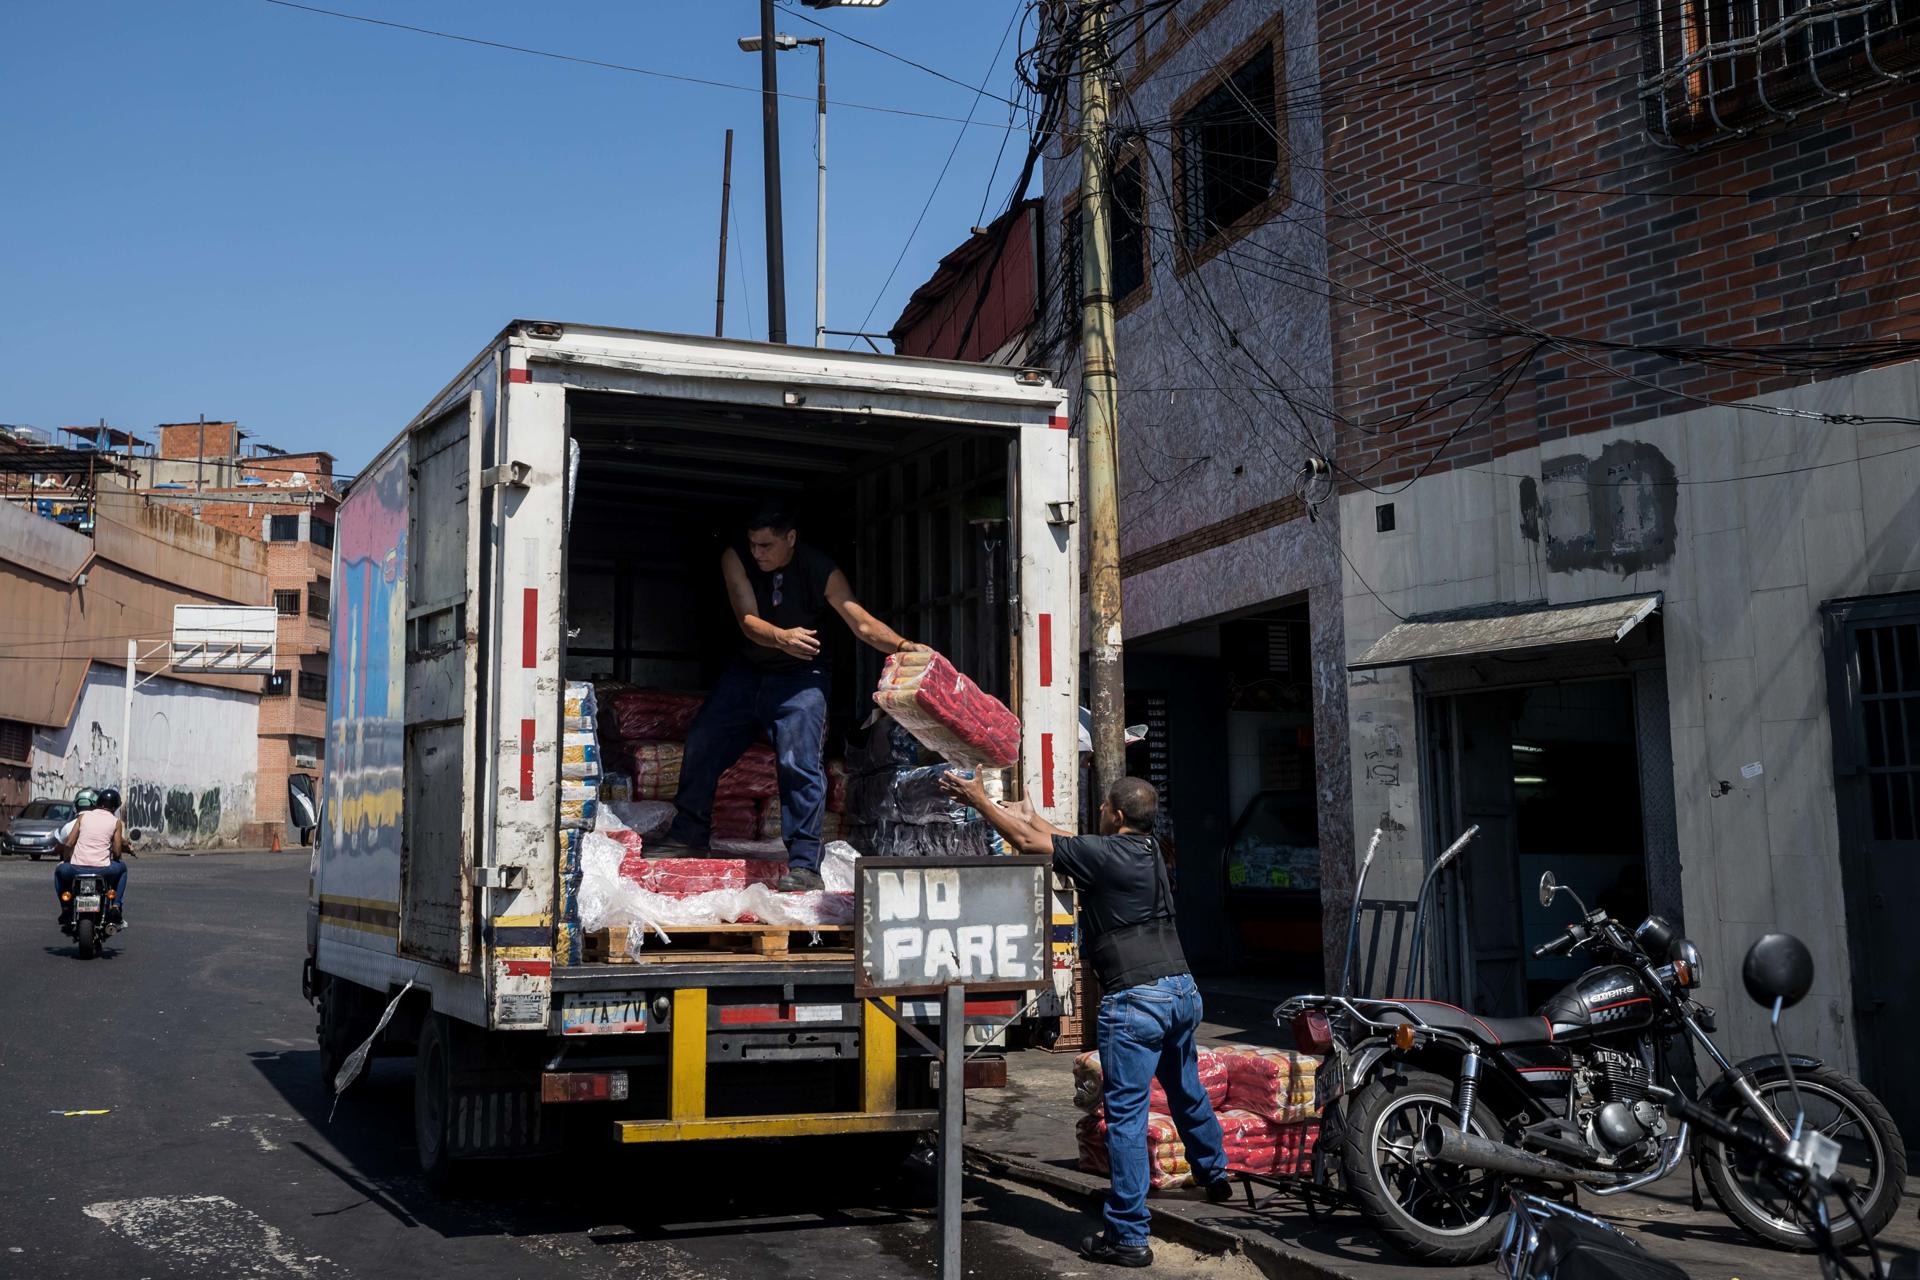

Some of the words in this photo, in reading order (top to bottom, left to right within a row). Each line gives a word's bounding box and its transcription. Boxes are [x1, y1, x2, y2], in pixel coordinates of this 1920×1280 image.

[877, 869, 960, 921] NO
[883, 924, 1028, 980] PARE
[1589, 984, 1634, 1003] EMPIRE
